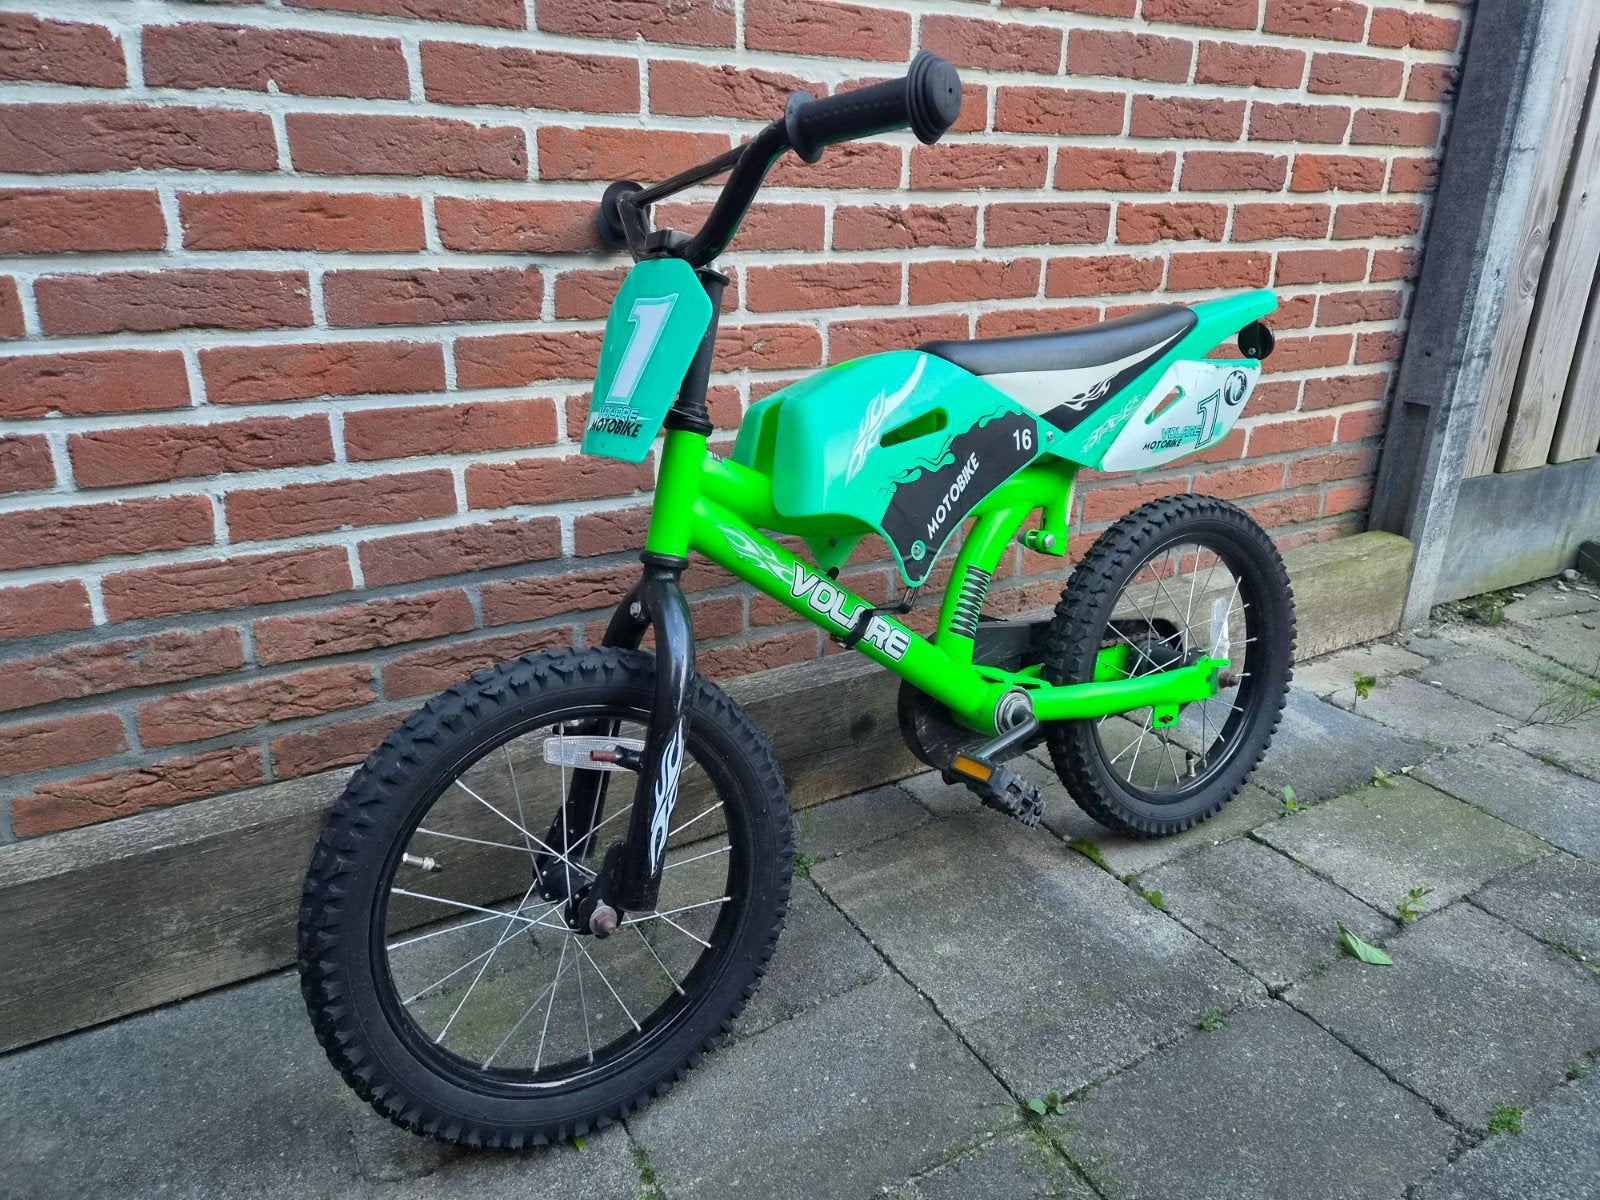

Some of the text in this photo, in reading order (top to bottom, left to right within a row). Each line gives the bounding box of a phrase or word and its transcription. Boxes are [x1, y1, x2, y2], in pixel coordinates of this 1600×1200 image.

[605, 293, 680, 405] 1
[589, 417, 643, 438] MOTOBIKE
[1194, 388, 1220, 449] 1
[1012, 428, 1032, 451] 16
[1161, 424, 1202, 440] VOLARE
[1142, 438, 1182, 451] MOTOBIKE
[927, 451, 980, 540] MOTOBIKE
